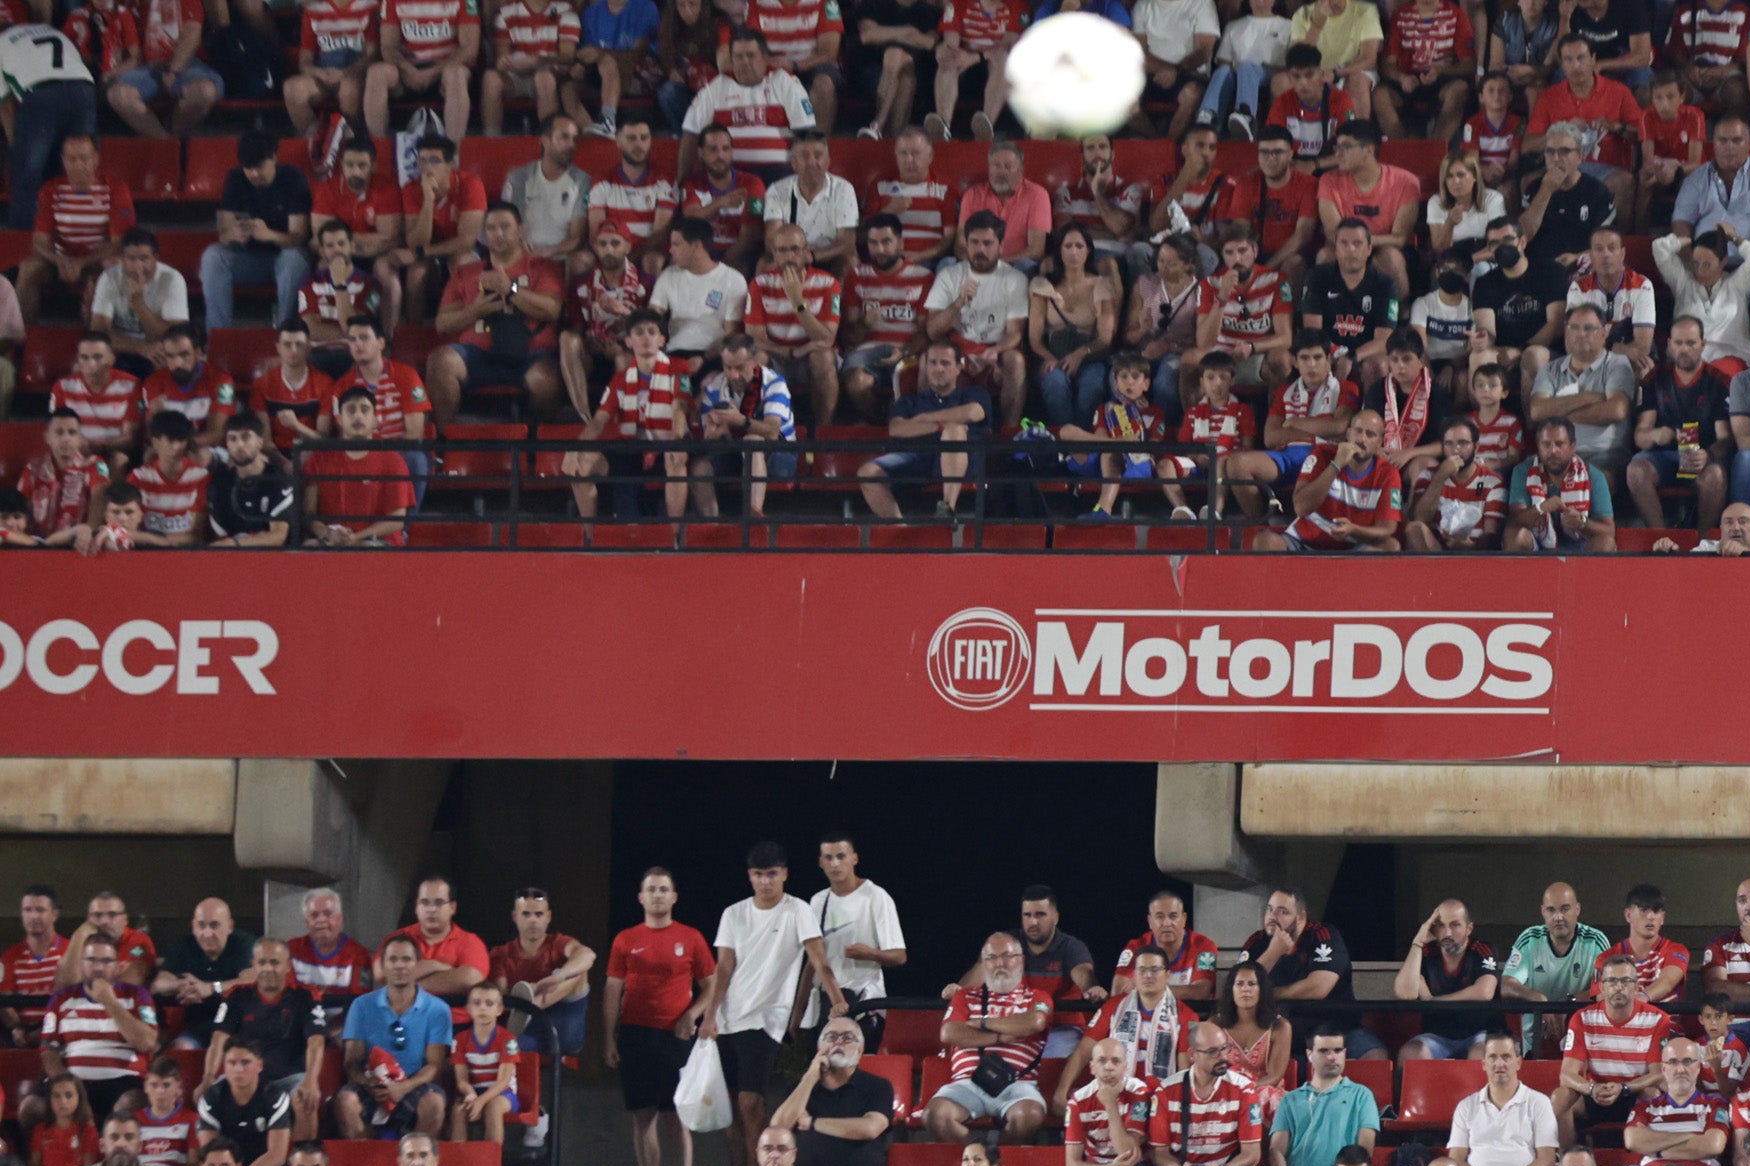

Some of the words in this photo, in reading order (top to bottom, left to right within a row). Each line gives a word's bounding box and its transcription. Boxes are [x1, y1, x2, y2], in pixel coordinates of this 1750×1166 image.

[31, 36, 63, 69] 7
[953, 638, 1008, 682] FIAT
[1031, 621, 1554, 700] MotorDOS
